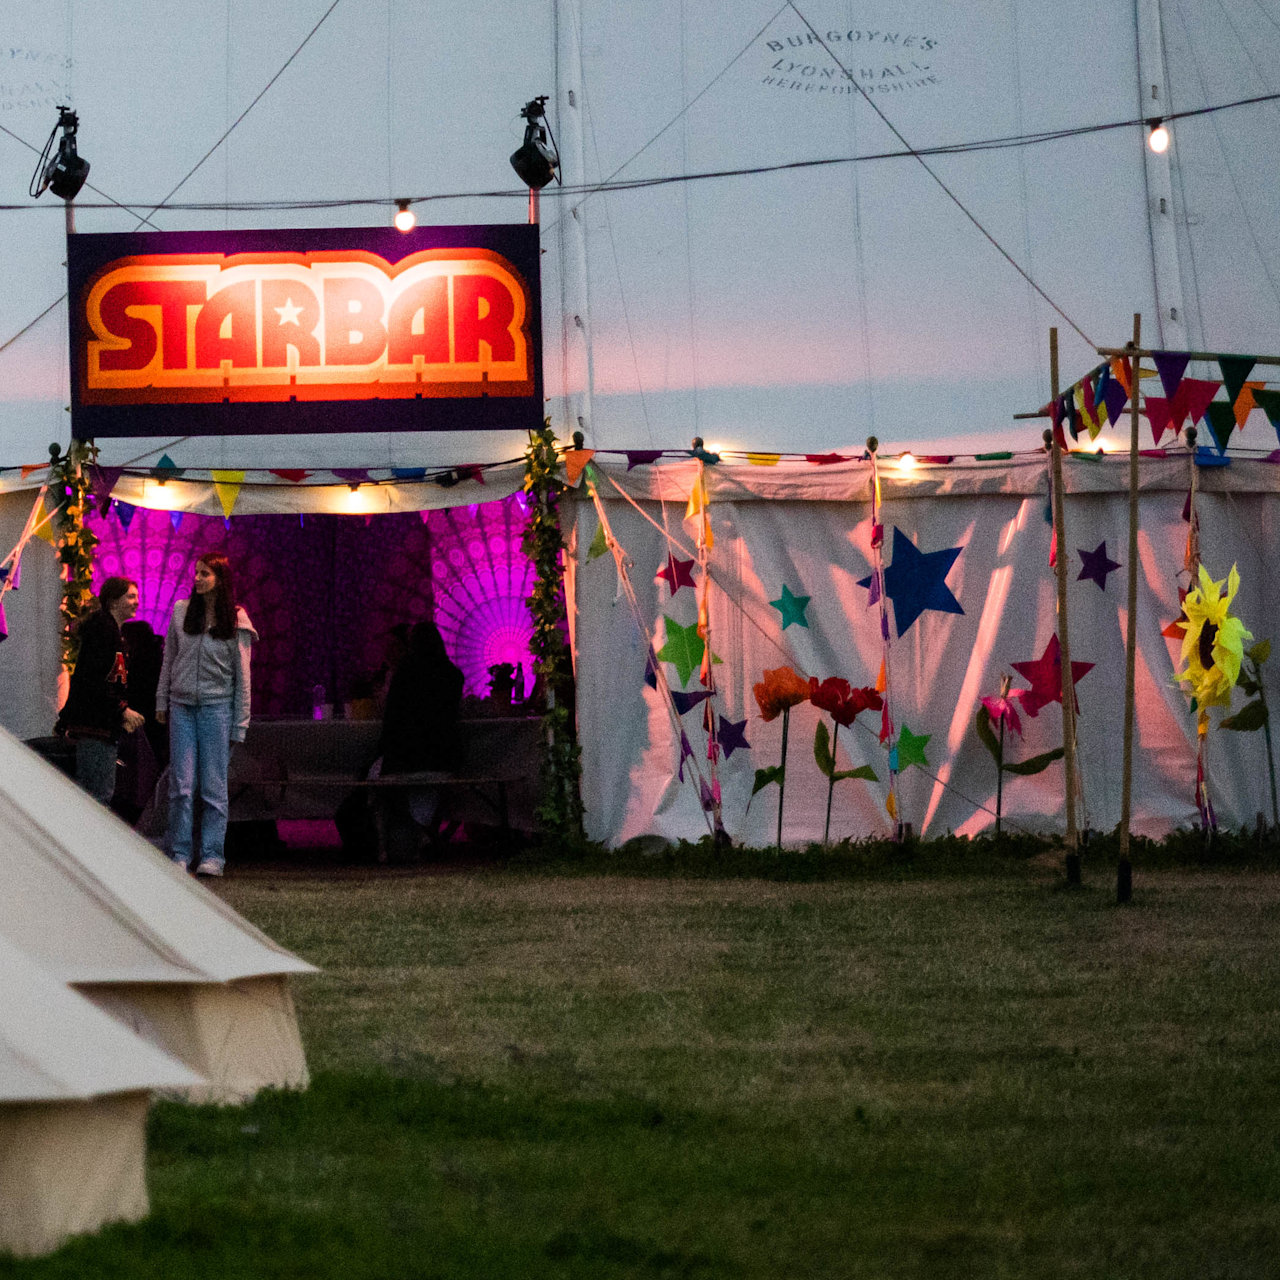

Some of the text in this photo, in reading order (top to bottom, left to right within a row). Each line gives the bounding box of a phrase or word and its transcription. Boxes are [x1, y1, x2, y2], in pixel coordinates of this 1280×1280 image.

[766, 29, 938, 53] BURGOYNE'S
[94, 270, 520, 376] STARBAR
[106, 651, 128, 684] A
